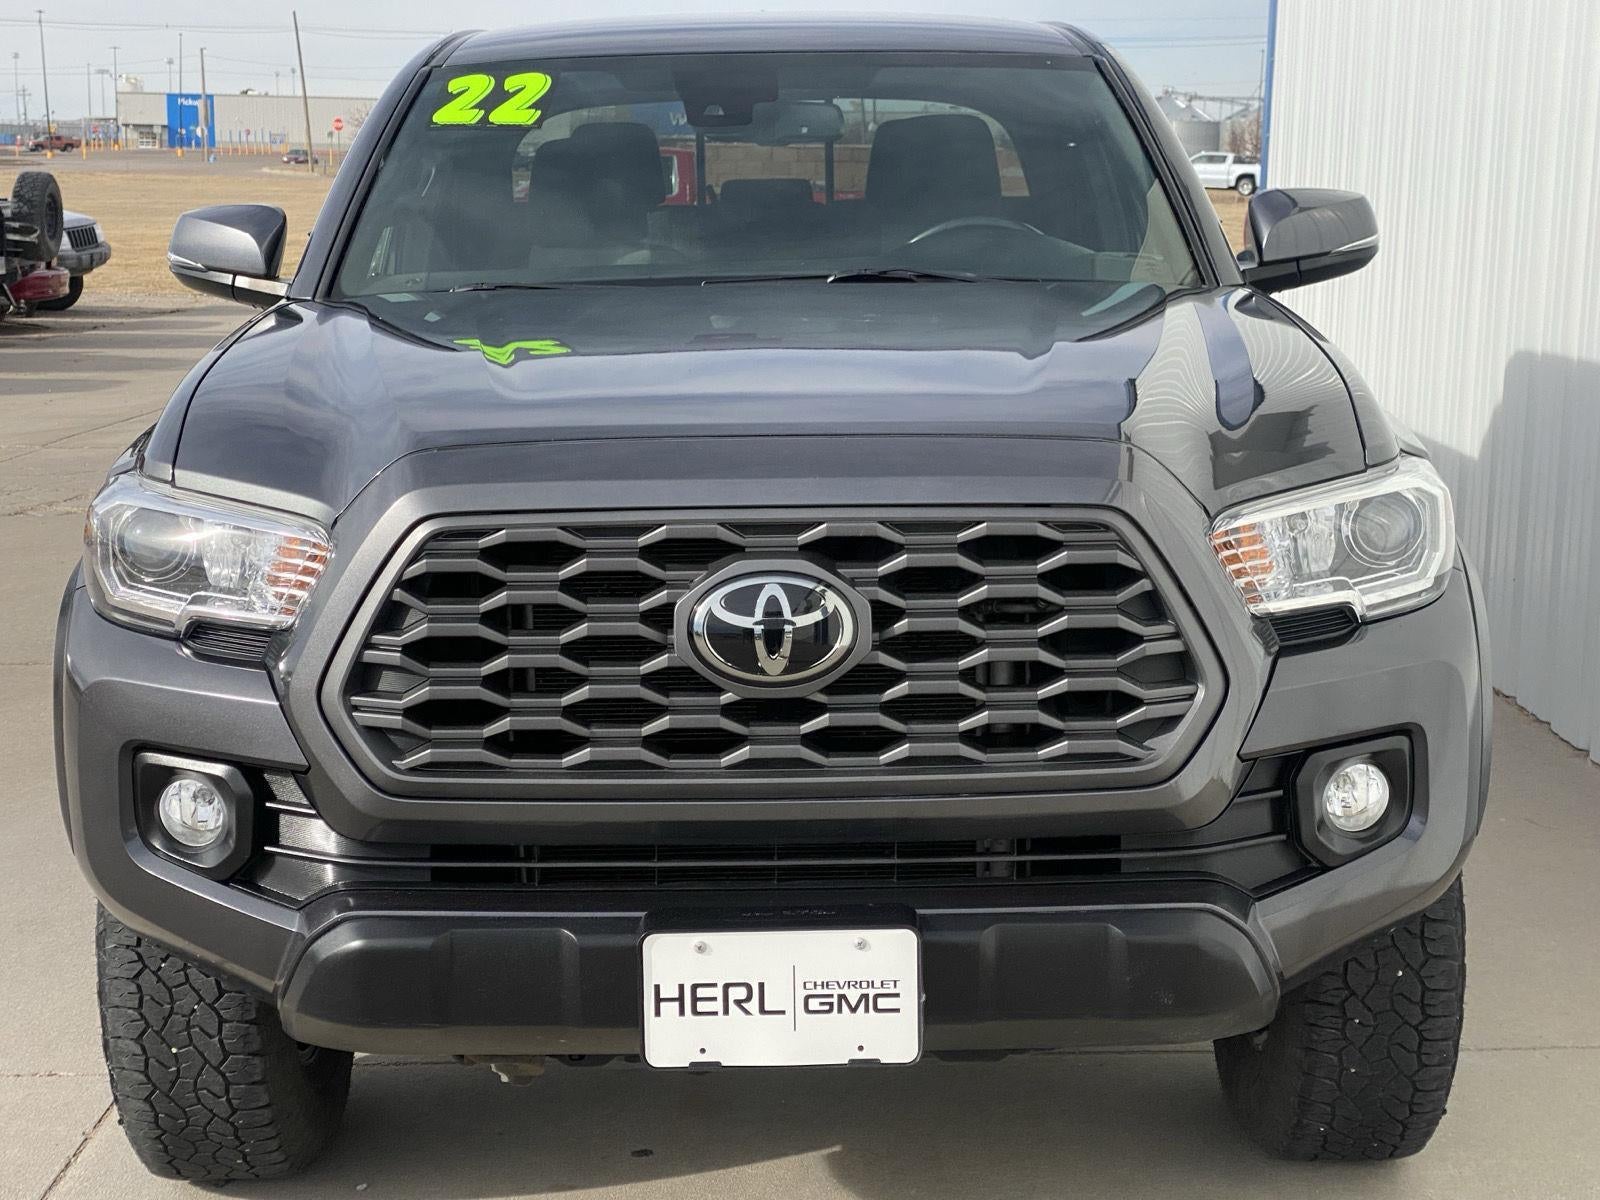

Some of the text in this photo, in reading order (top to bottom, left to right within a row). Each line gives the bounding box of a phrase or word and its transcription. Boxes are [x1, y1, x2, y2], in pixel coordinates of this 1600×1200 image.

[432, 72, 552, 125] 22
[653, 981, 786, 1018] HERL
[803, 979, 901, 991] CHEVROLET
[803, 992, 901, 1015] GMC
